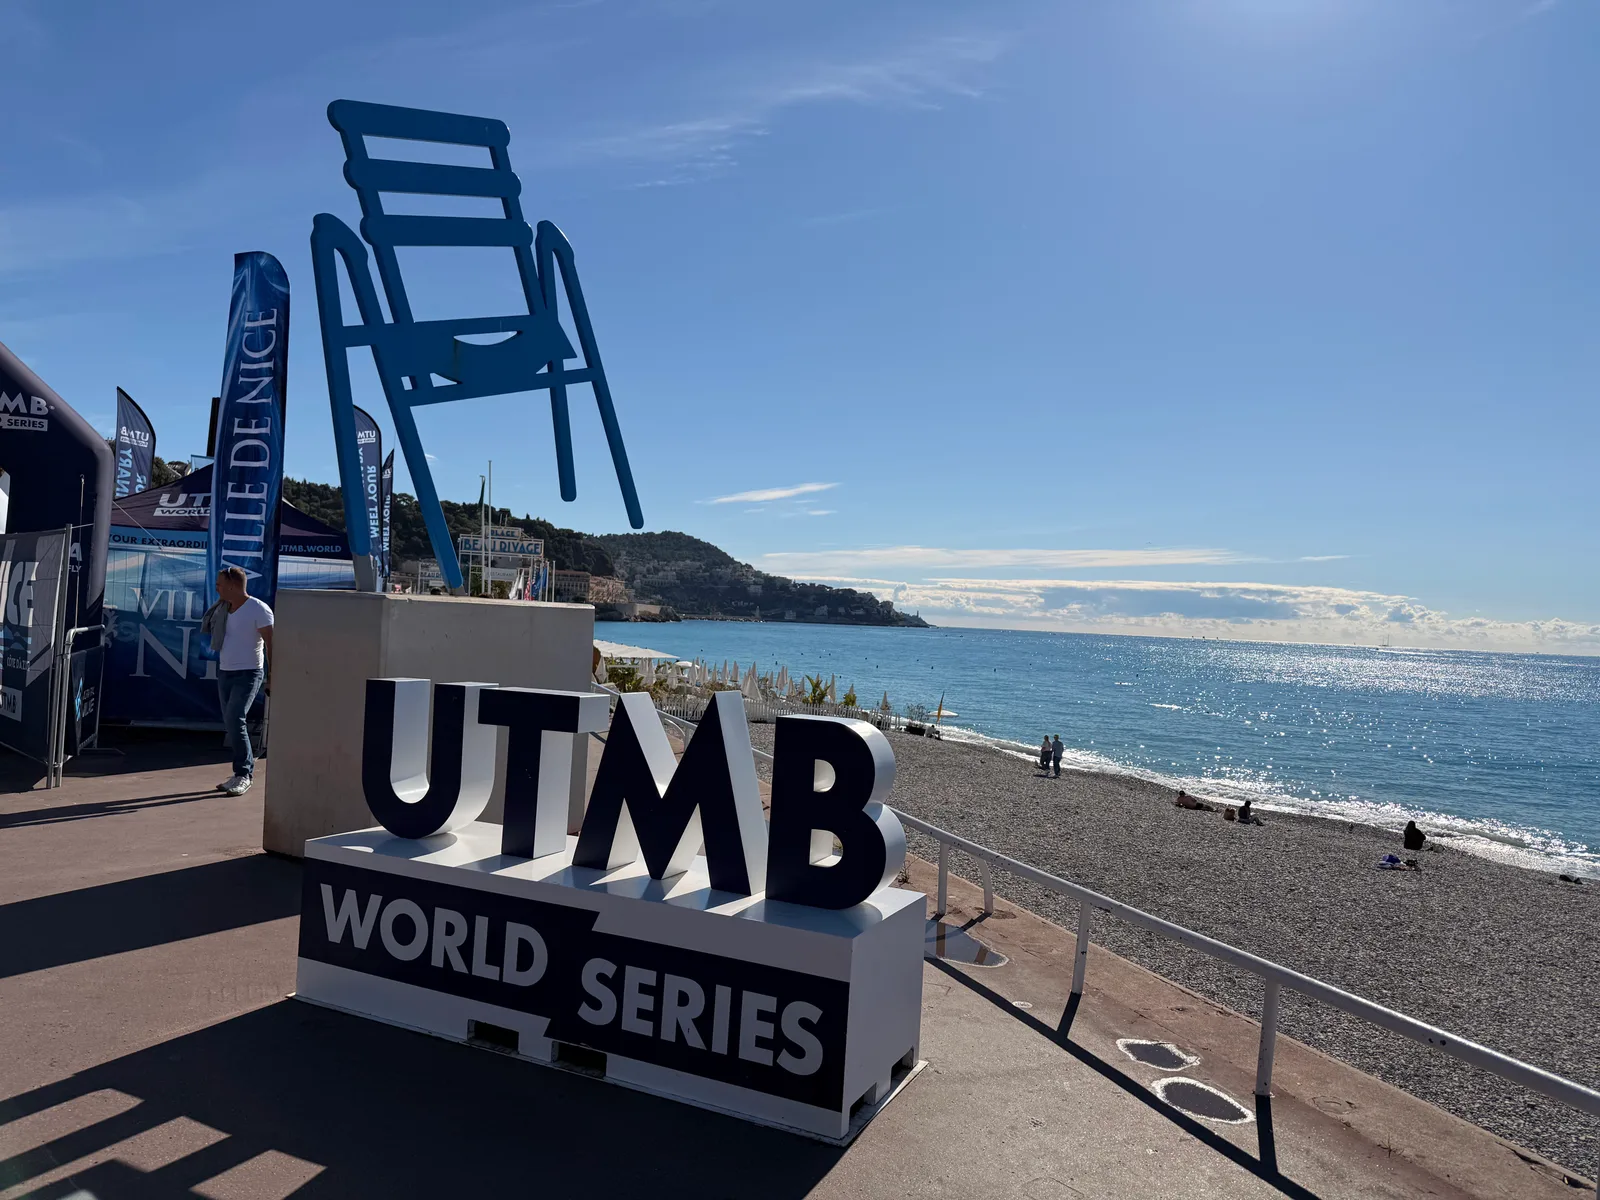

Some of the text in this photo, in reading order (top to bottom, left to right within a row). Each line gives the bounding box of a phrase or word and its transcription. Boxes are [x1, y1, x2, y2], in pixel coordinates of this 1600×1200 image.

[236, 307, 278, 405] NICE
[7, 418, 45, 428] SERIES
[229, 416, 272, 470] DE
[159, 493, 211, 507] UT
[141, 537, 208, 549] EXTRAORDI
[361, 677, 908, 910] UTMB
[319, 882, 549, 988] WORLD
[577, 956, 825, 1077] SERIES
